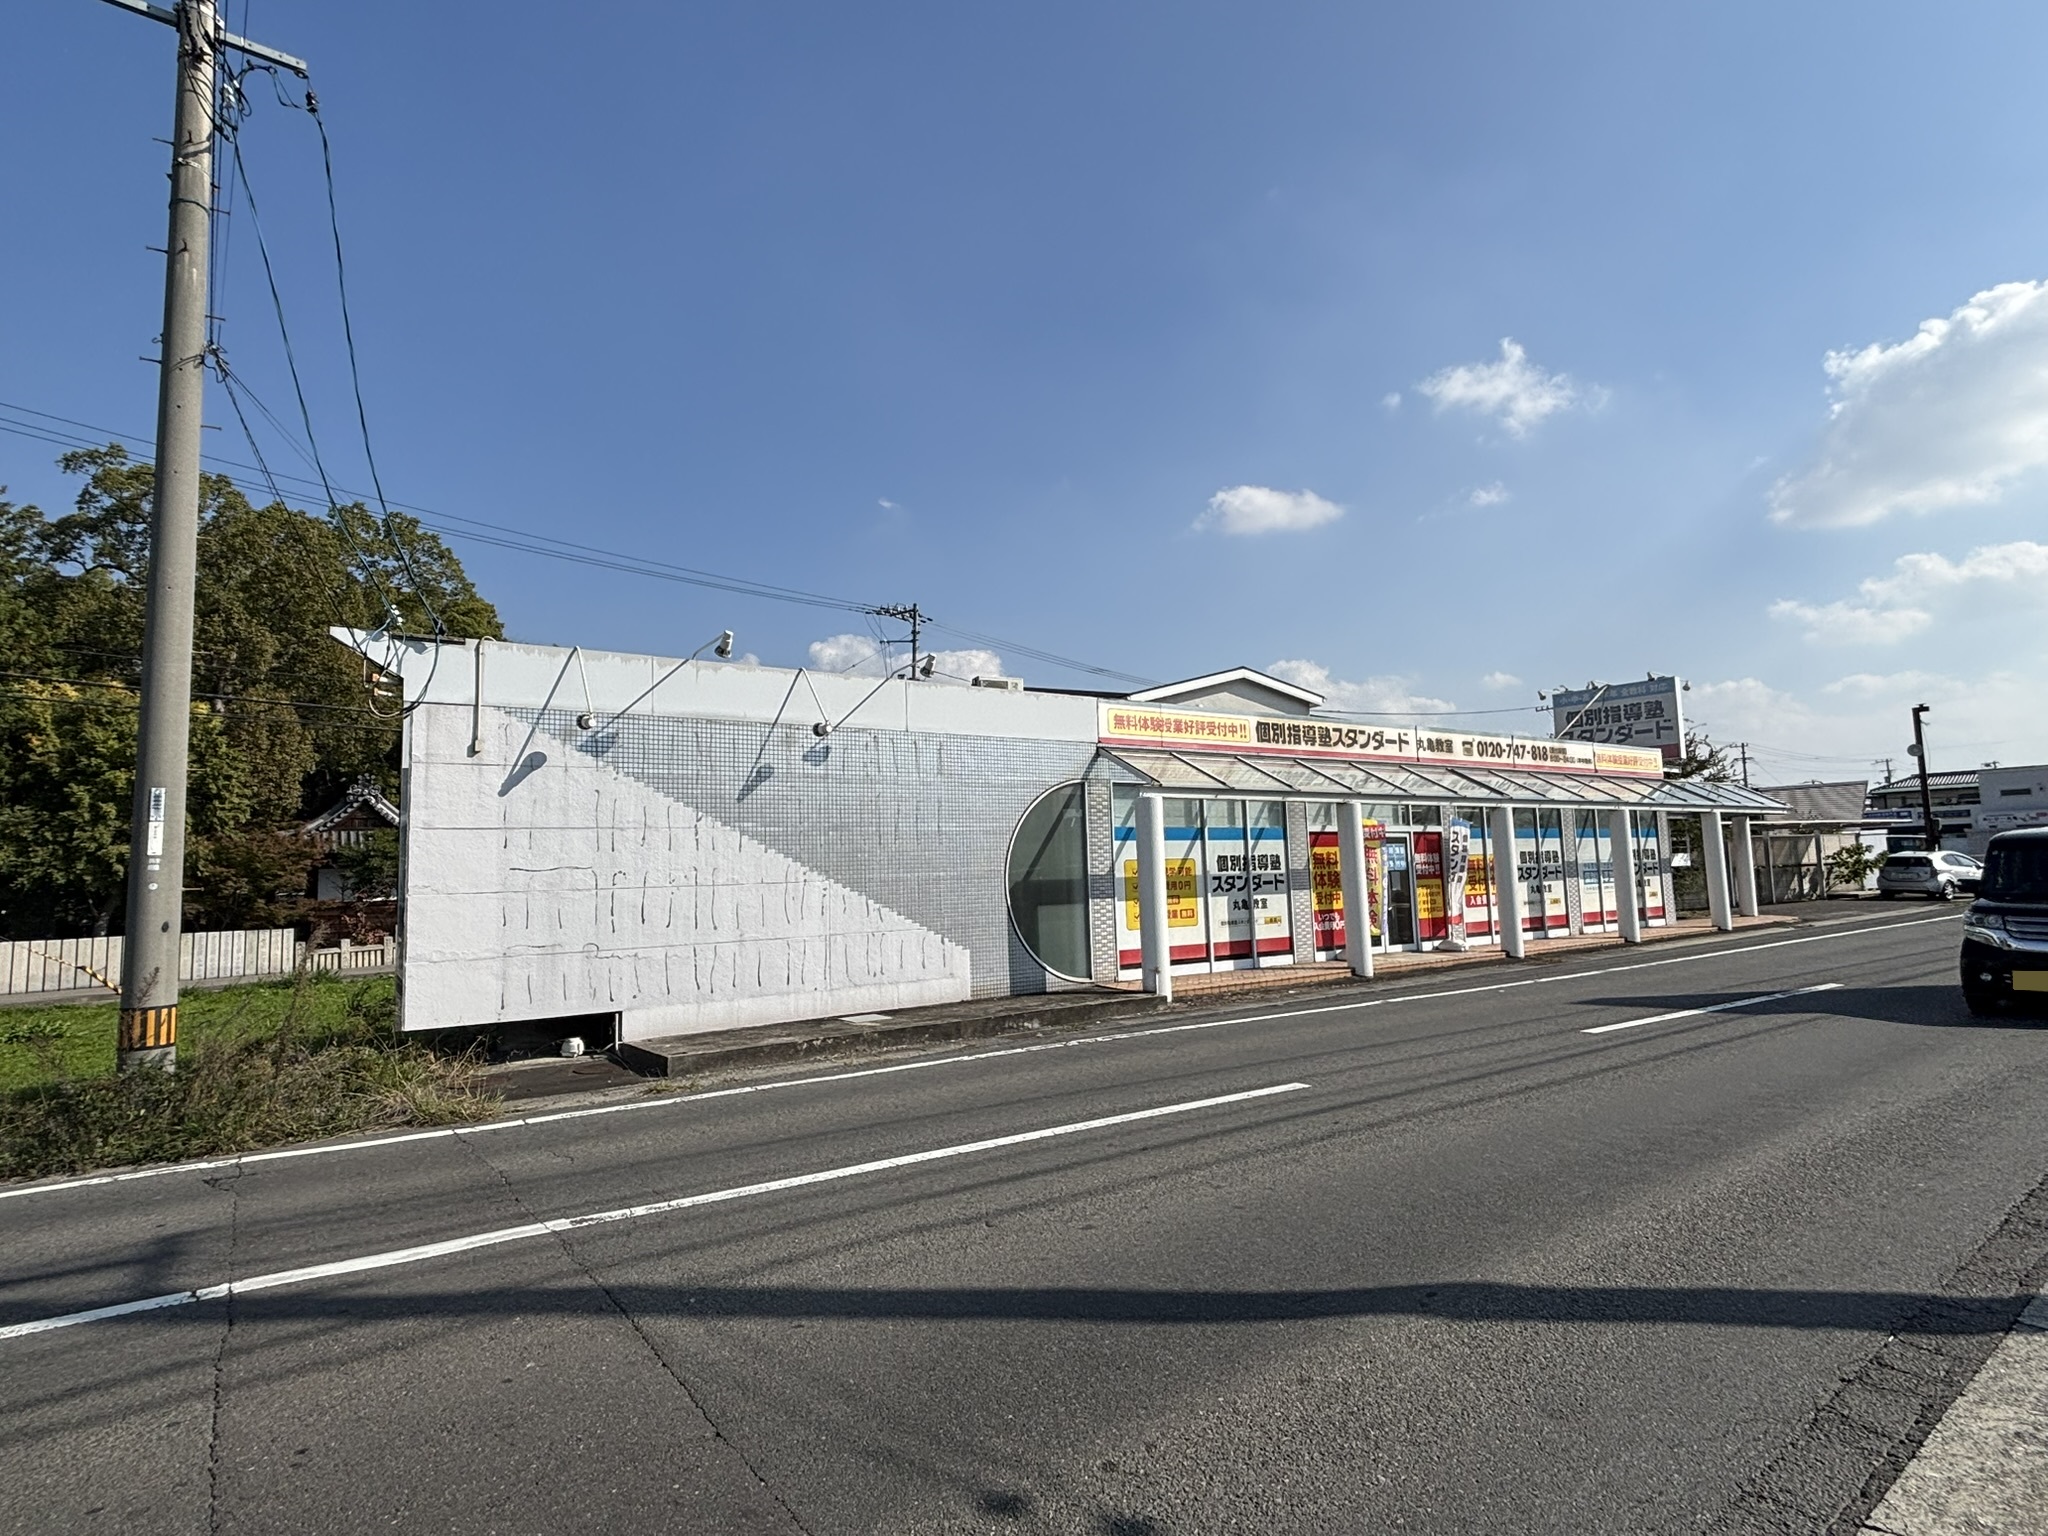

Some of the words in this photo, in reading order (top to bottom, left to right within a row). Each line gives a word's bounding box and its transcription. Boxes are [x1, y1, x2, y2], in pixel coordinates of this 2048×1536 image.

[1565, 700, 1665, 728] 個別指導塾
[1255, 720, 1410, 753] 個別指導塾スタンダード
[1416, 737, 1453, 754] 丸亀教室
[1313, 851, 1338, 870] 無料
[1414, 853, 1439, 863] 無料体験
[1314, 871, 1340, 890] 体験
[1518, 865, 1562, 880] スタンダード
[1212, 873, 1284, 892] スタンダード
[1315, 892, 1341, 905] 受付中
